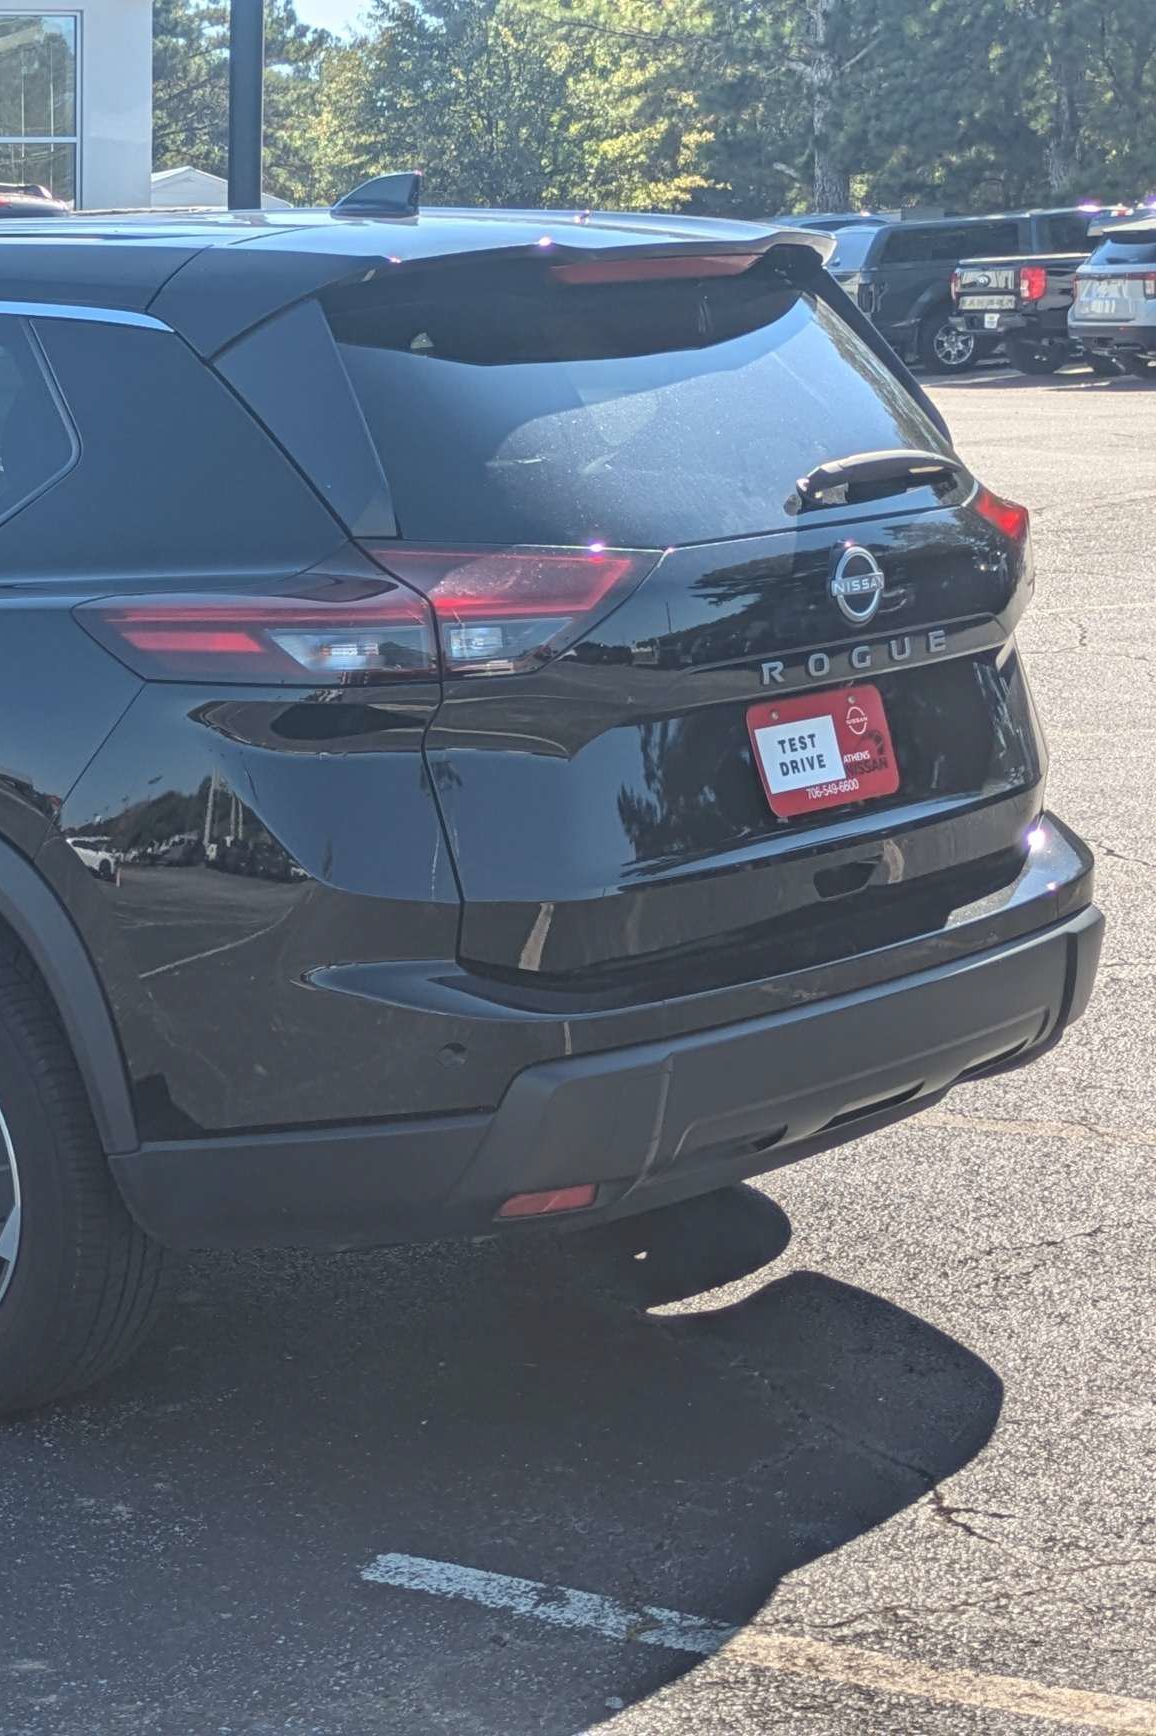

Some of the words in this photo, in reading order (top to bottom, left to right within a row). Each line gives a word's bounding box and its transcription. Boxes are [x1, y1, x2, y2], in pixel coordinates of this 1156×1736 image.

[834, 574, 882, 595] NISSAN
[761, 630, 946, 686] ROGUE
[777, 733, 816, 754] TEST
[779, 754, 826, 777] DRIVE
[843, 750, 870, 763] ATHENS
[806, 778, 859, 800] 706-549-6600
